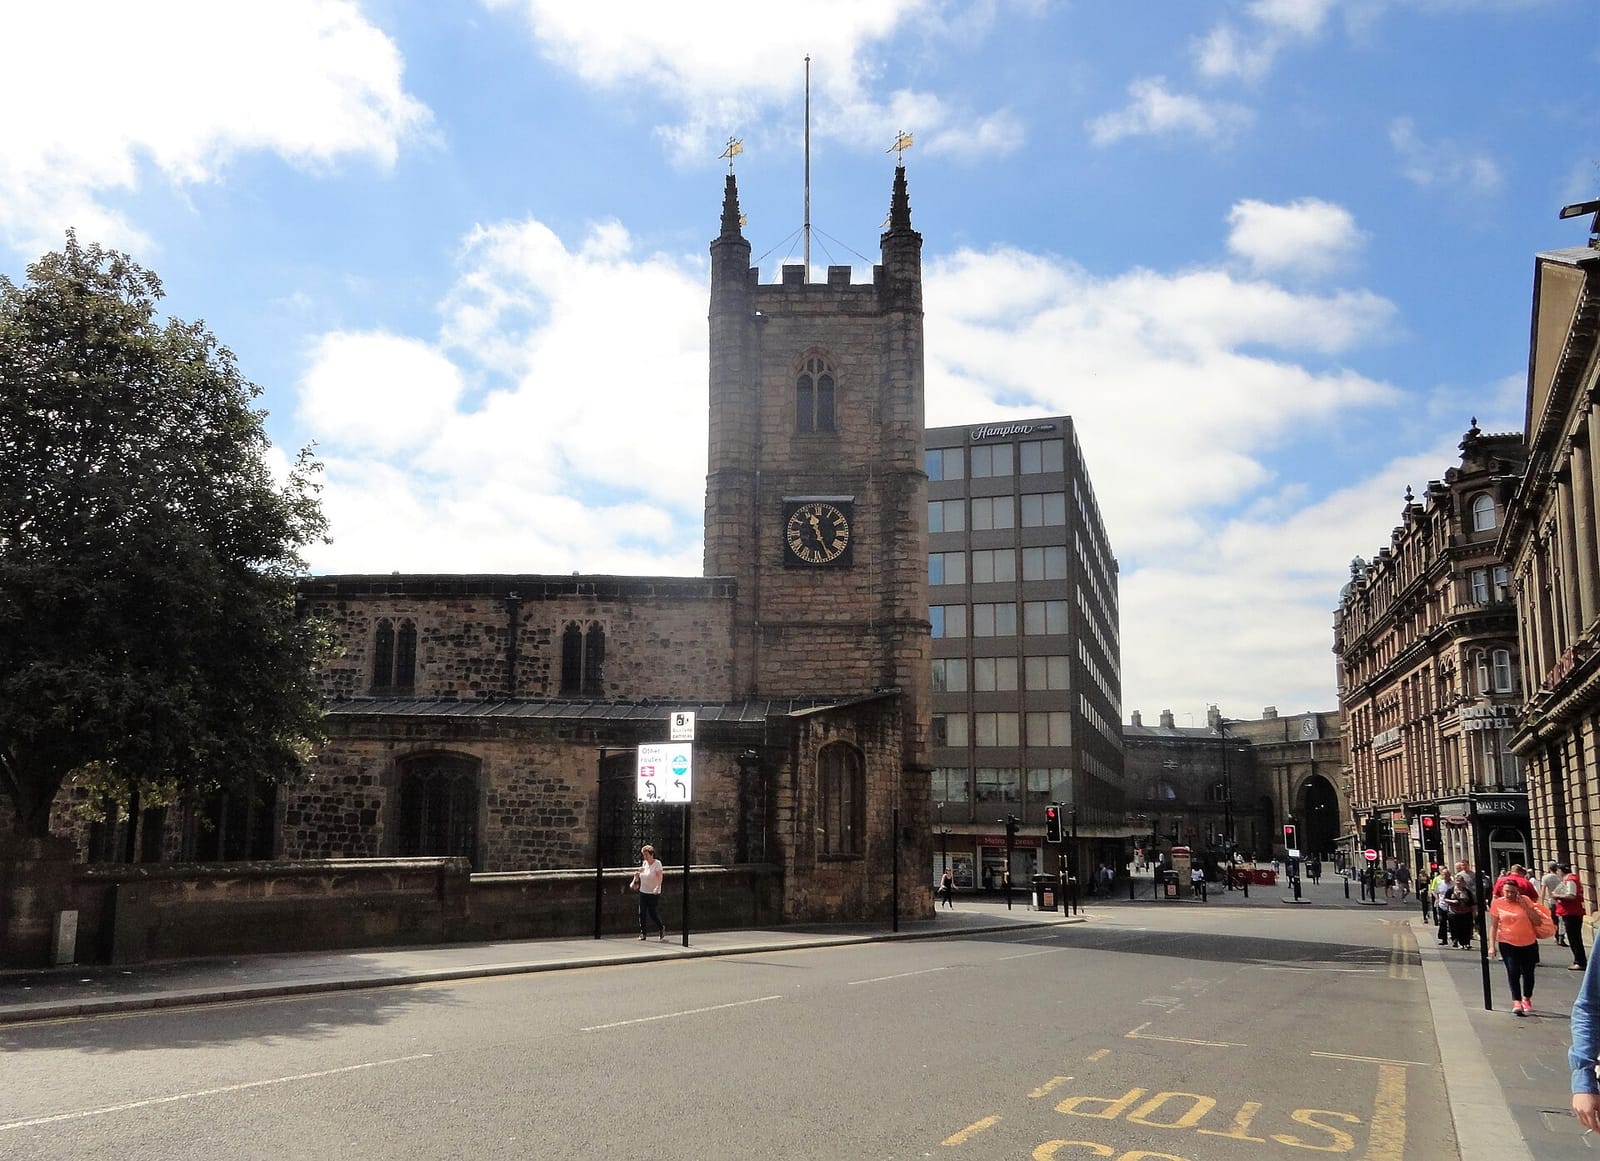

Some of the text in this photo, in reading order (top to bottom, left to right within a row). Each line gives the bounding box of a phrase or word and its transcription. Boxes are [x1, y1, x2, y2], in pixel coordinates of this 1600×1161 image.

[971, 424, 1033, 440] Hampton
[1462, 717, 1514, 731] HOTEL
[1476, 800, 1516, 812] OWERS
[1054, 1087, 1361, 1153] STOP
